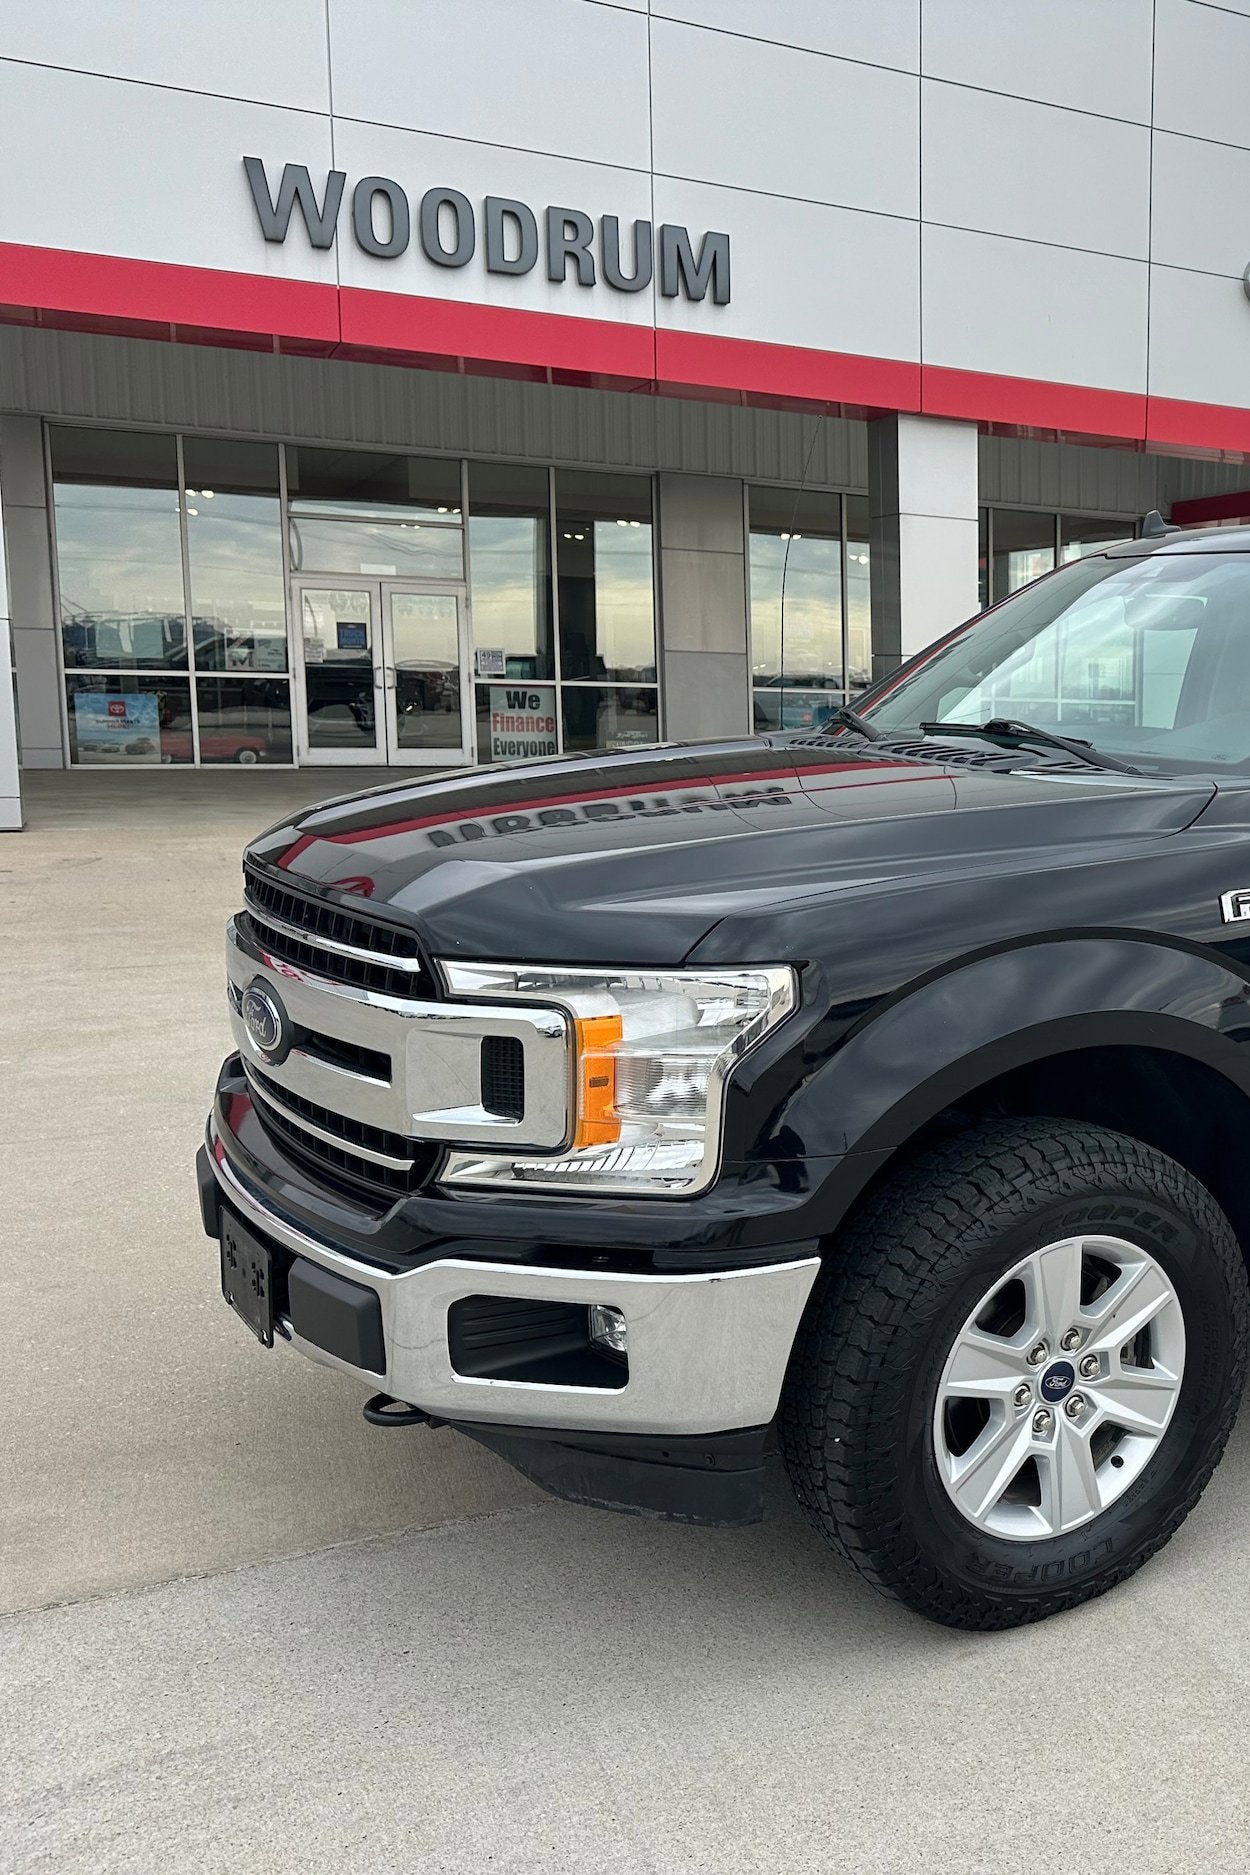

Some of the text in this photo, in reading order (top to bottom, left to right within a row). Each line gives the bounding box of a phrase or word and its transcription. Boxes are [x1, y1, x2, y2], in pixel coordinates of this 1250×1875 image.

[243, 155, 731, 305] WOODRUM
[506, 690, 541, 710] We
[491, 712, 556, 733] Finance
[493, 737, 557, 758] Everyone
[245, 999, 268, 1038] Ford
